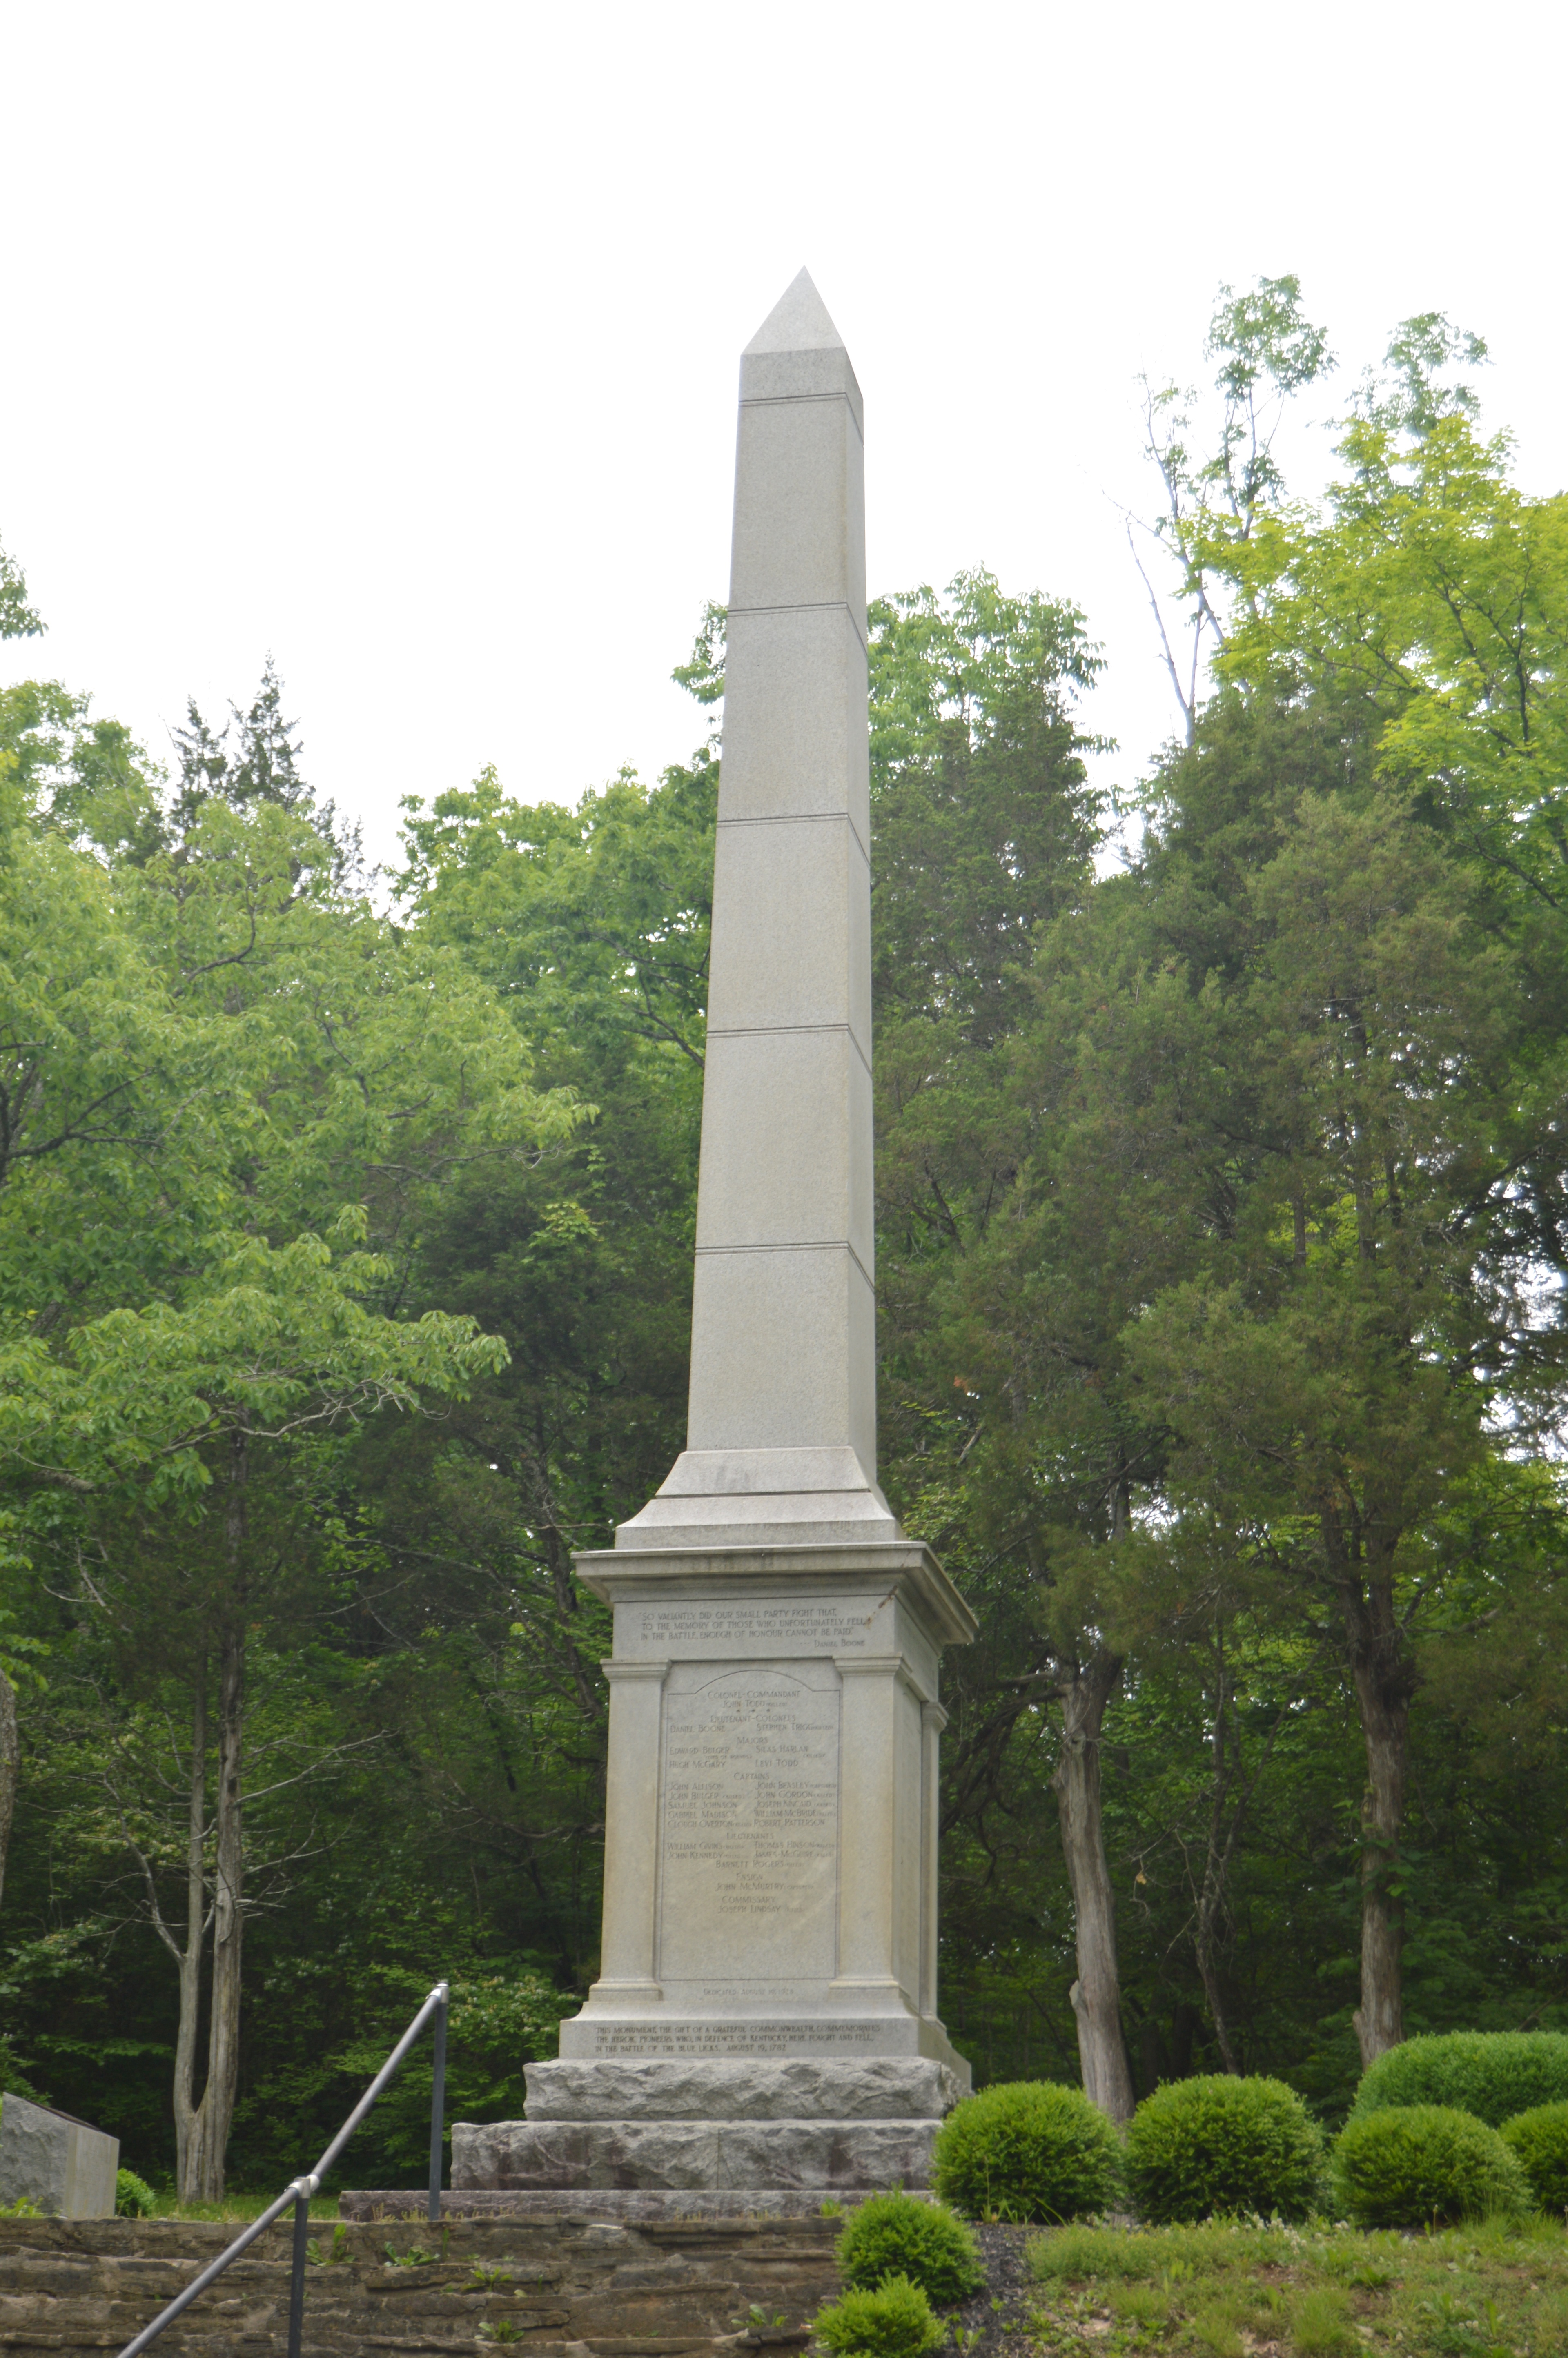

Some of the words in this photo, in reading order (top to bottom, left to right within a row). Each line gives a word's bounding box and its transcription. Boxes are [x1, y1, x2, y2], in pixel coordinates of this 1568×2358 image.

[699, 1612, 711, 1620] DID
[736, 1610, 761, 1619] SMALL
[792, 1609, 814, 1617] FIGHT
[642, 1623, 653, 1631] TO
[657, 1622, 670, 1630] THE
[674, 1622, 709, 1630] MEMORY
[726, 1621, 753, 1629] THOSE
[757, 1620, 776, 1628] WHO
[779, 1618, 844, 1627] UNFORTUNATELY
[699, 1631, 731, 1639] ENOUGH
[734, 1630, 745, 1639] OF
[749, 1630, 782, 1638] HONOUR
[786, 1629, 817, 1637] CANNOT
